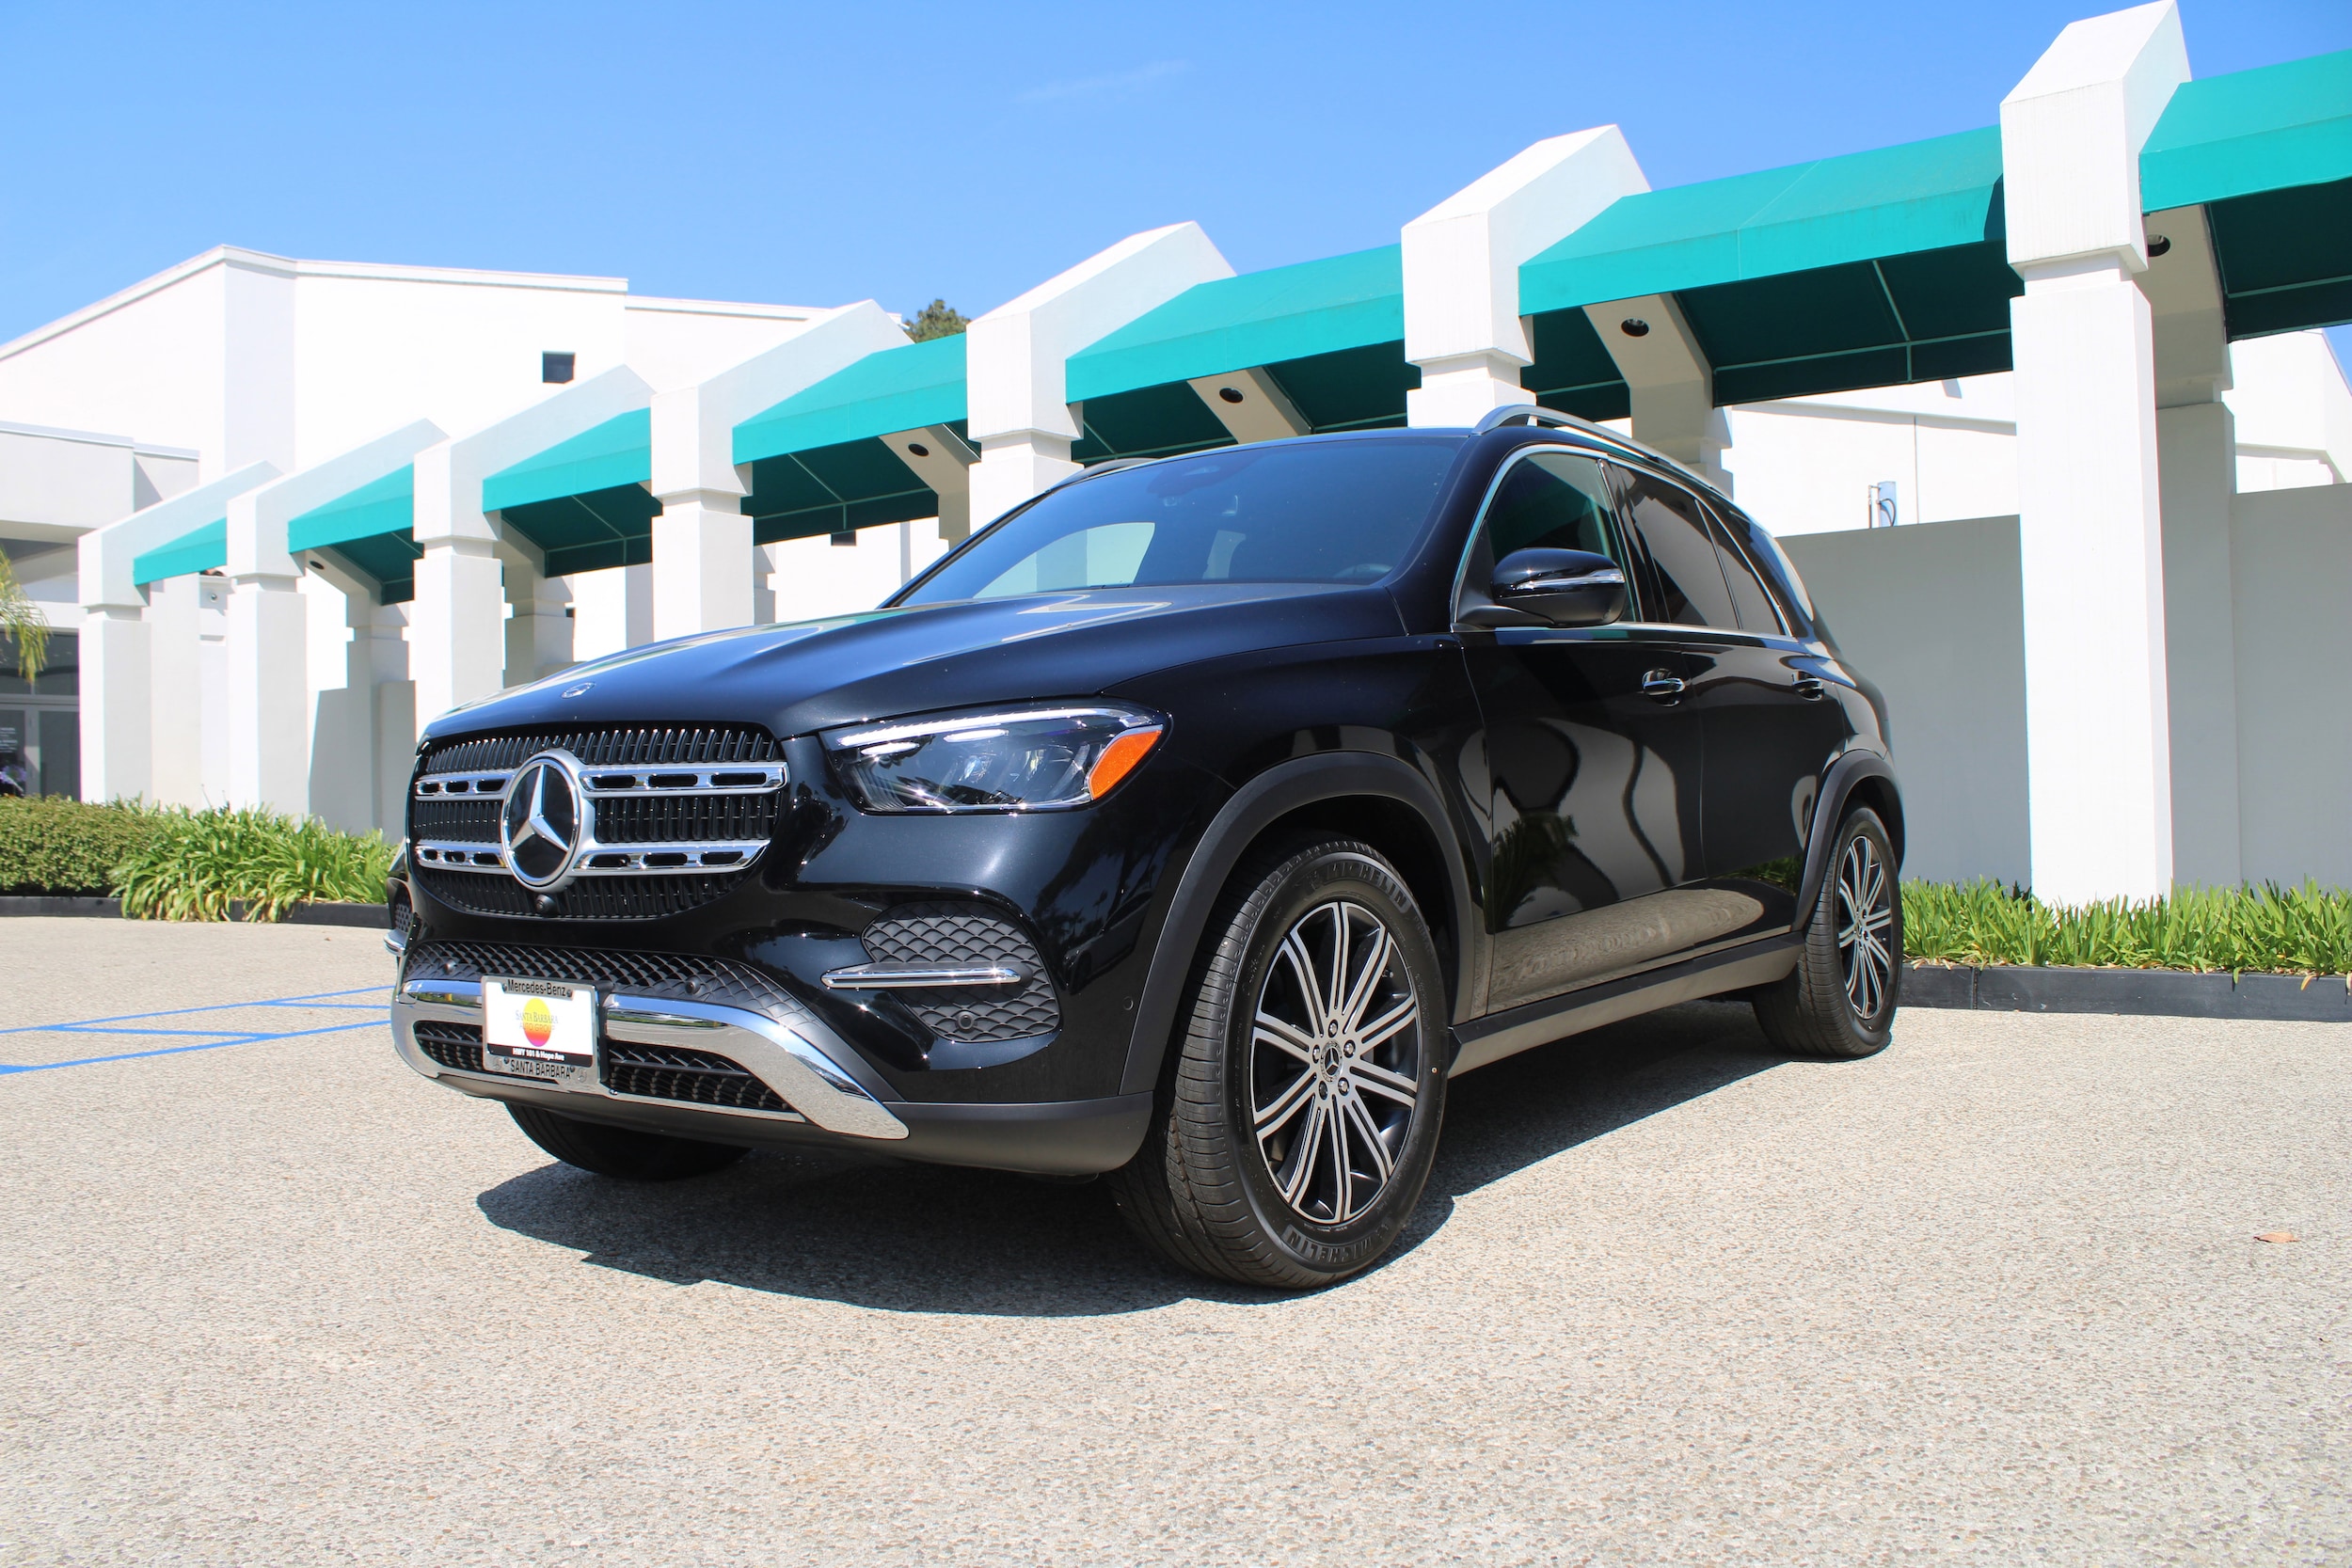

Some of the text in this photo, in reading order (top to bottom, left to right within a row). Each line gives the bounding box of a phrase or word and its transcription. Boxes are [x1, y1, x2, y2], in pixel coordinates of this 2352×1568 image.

[1327, 861, 1407, 906] MICHELIN
[507, 979, 566, 996] Mercedes-Benz
[516, 1009, 559, 1024] SANTA BARBARA
[513, 1047, 525, 1055] HWY
[511, 1059, 571, 1079] SANTA BARBARA
